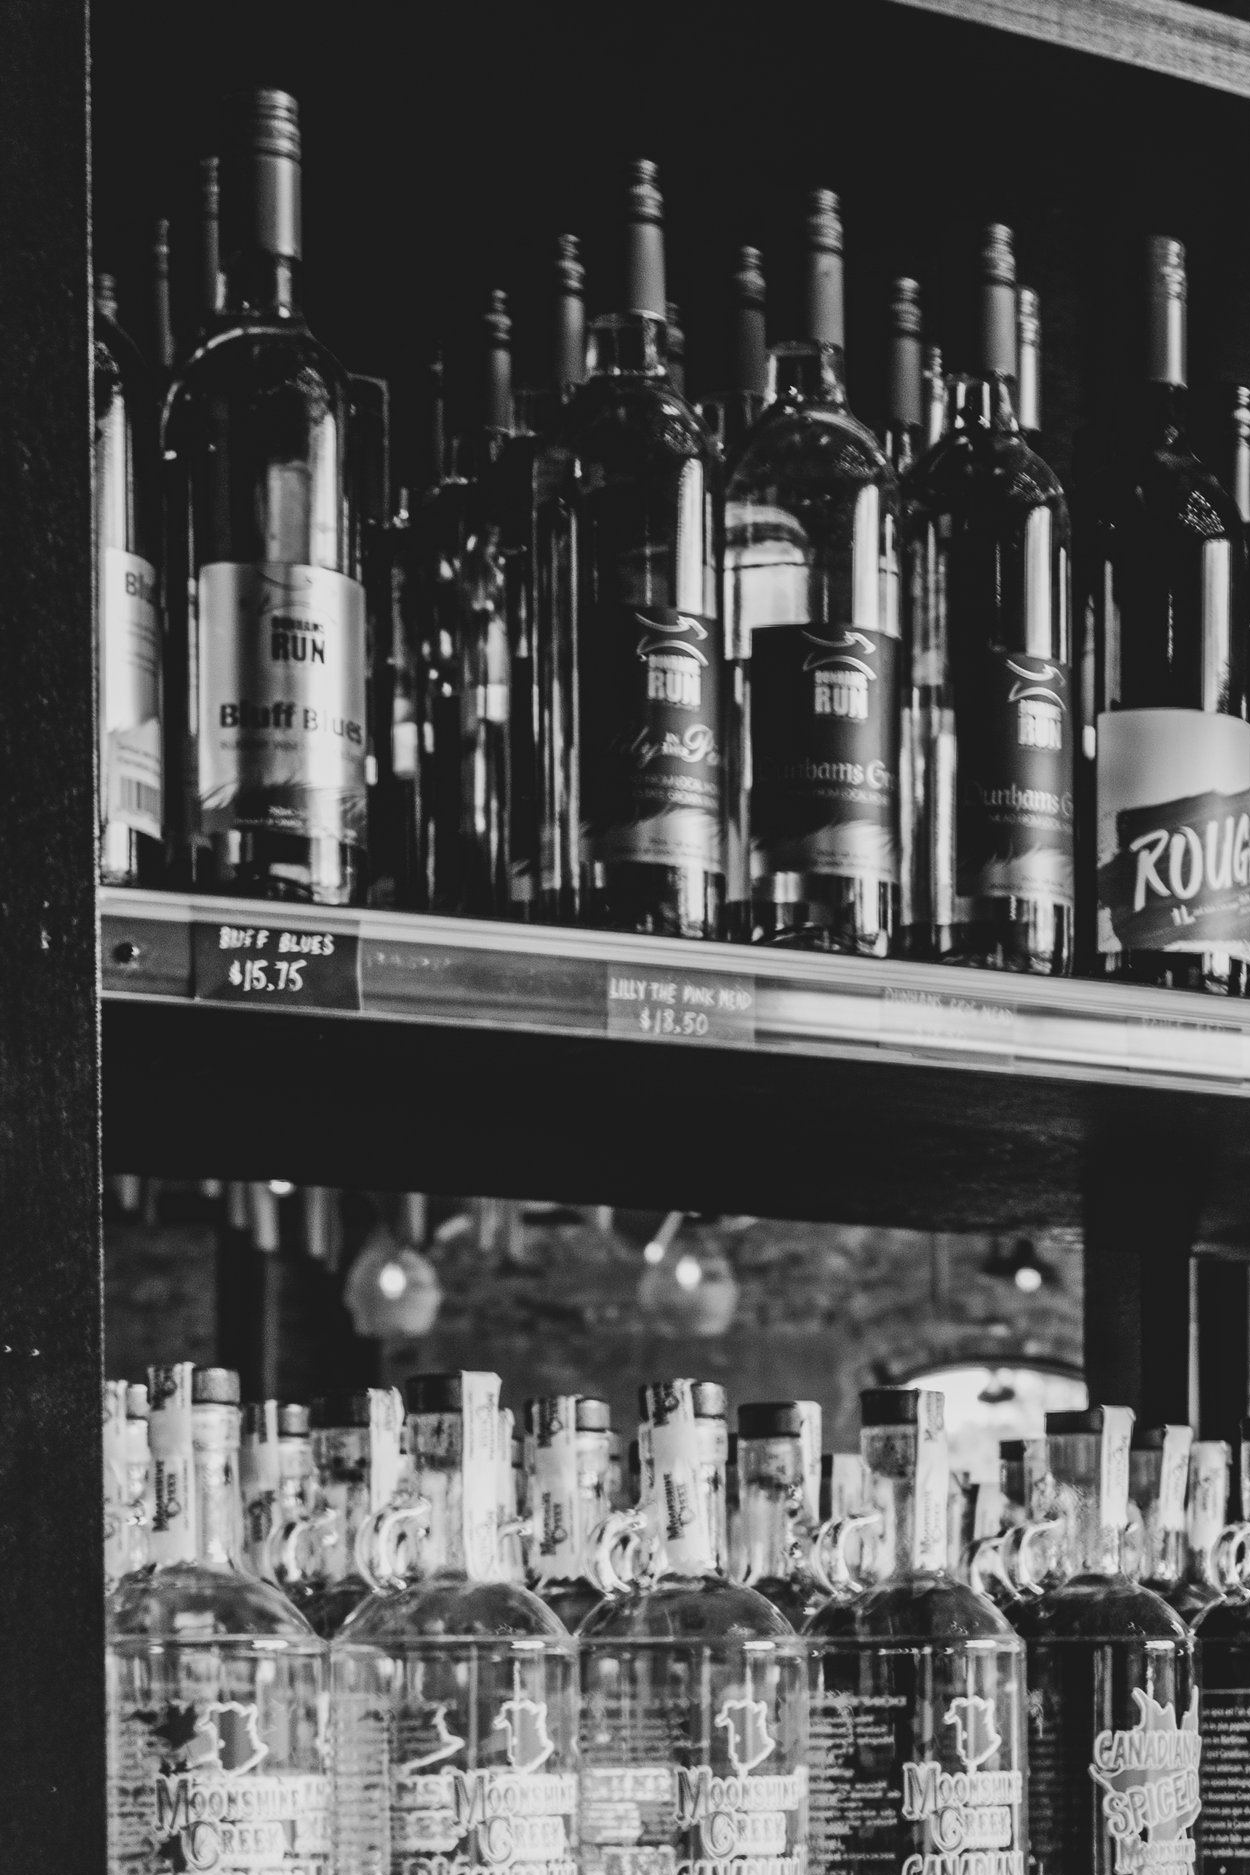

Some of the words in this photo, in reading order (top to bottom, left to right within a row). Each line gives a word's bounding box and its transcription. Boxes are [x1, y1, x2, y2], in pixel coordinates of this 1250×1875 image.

[270, 633, 325, 665] RUN
[647, 669, 701, 708] RUN
[814, 685, 868, 720] RUN
[219, 702, 297, 730] Bluff
[303, 706, 363, 747] Blues
[1018, 712, 1063, 751] RUN
[278, 932, 336, 956] BLUES
[228, 959, 308, 992] $15.75
[609, 976, 647, 1001] LILLY
[650, 981, 677, 1004] THE
[682, 984, 717, 1008] PINK
[719, 988, 753, 1011] MEAD
[639, 1008, 709, 1037] $18.50
[1094, 1729, 1201, 1776] CANADIANA
[153, 1773, 300, 1834] MOONSHINE
[1103, 1767, 1199, 1837] SPICED
[181, 1820, 281, 1871] CREEK
[479, 1815, 564, 1866] CREEK
[932, 1806, 1012, 1854] CREEK
